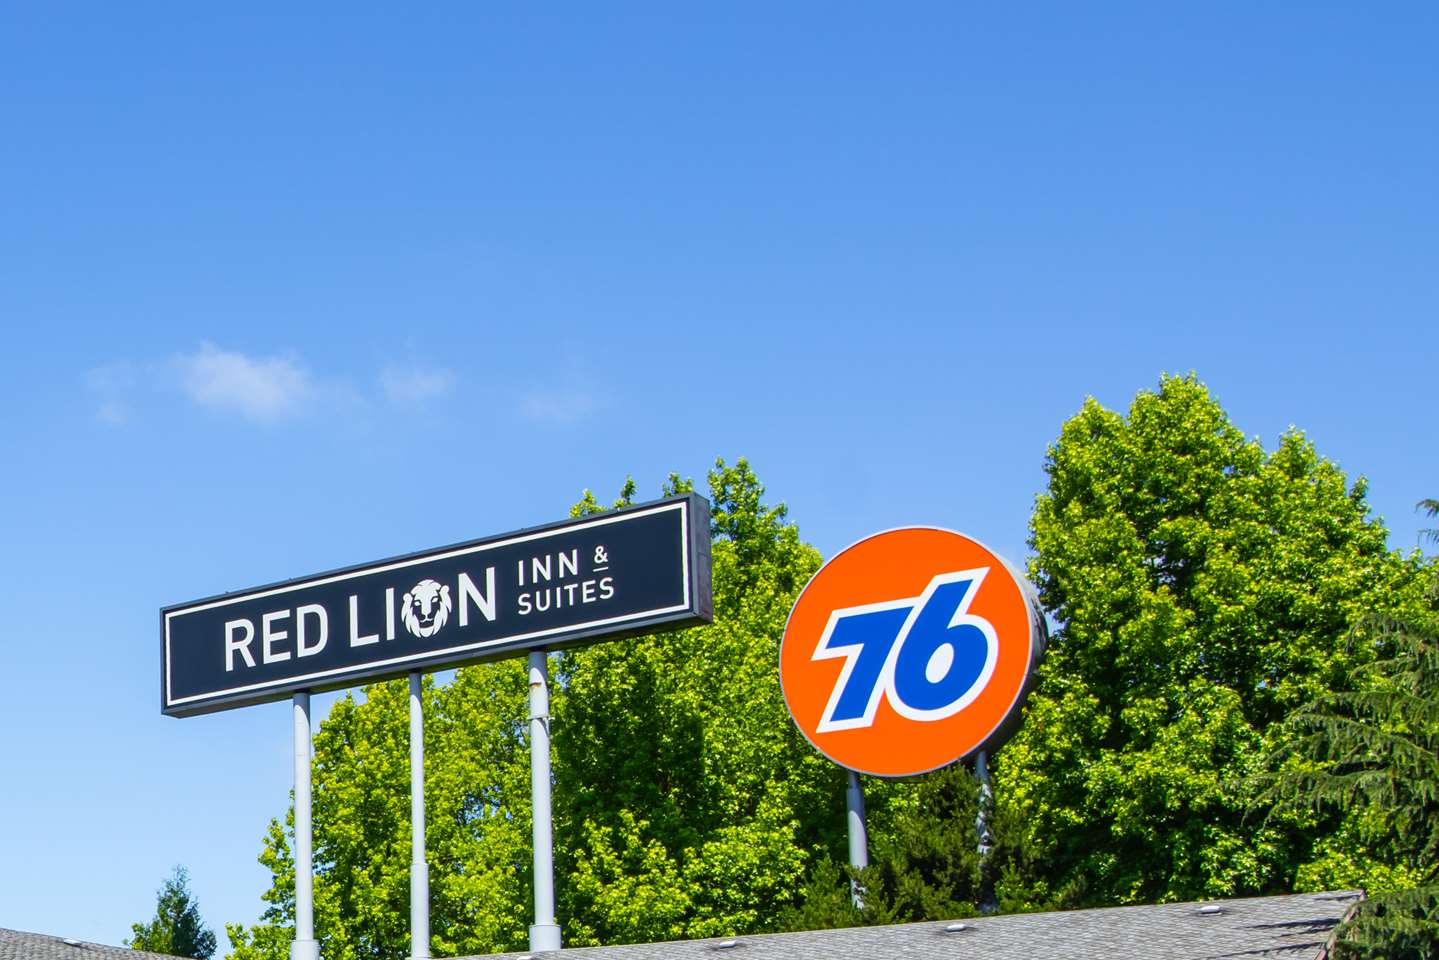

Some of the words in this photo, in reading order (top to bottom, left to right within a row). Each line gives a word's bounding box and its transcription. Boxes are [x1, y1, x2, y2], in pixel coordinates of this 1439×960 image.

[517, 577, 614, 615] SUITES
[518, 549, 578, 586] INN
[593, 545, 609, 564] &
[224, 603, 329, 672] RED
[349, 566, 496, 648] LION
[810, 566, 999, 734] 76
